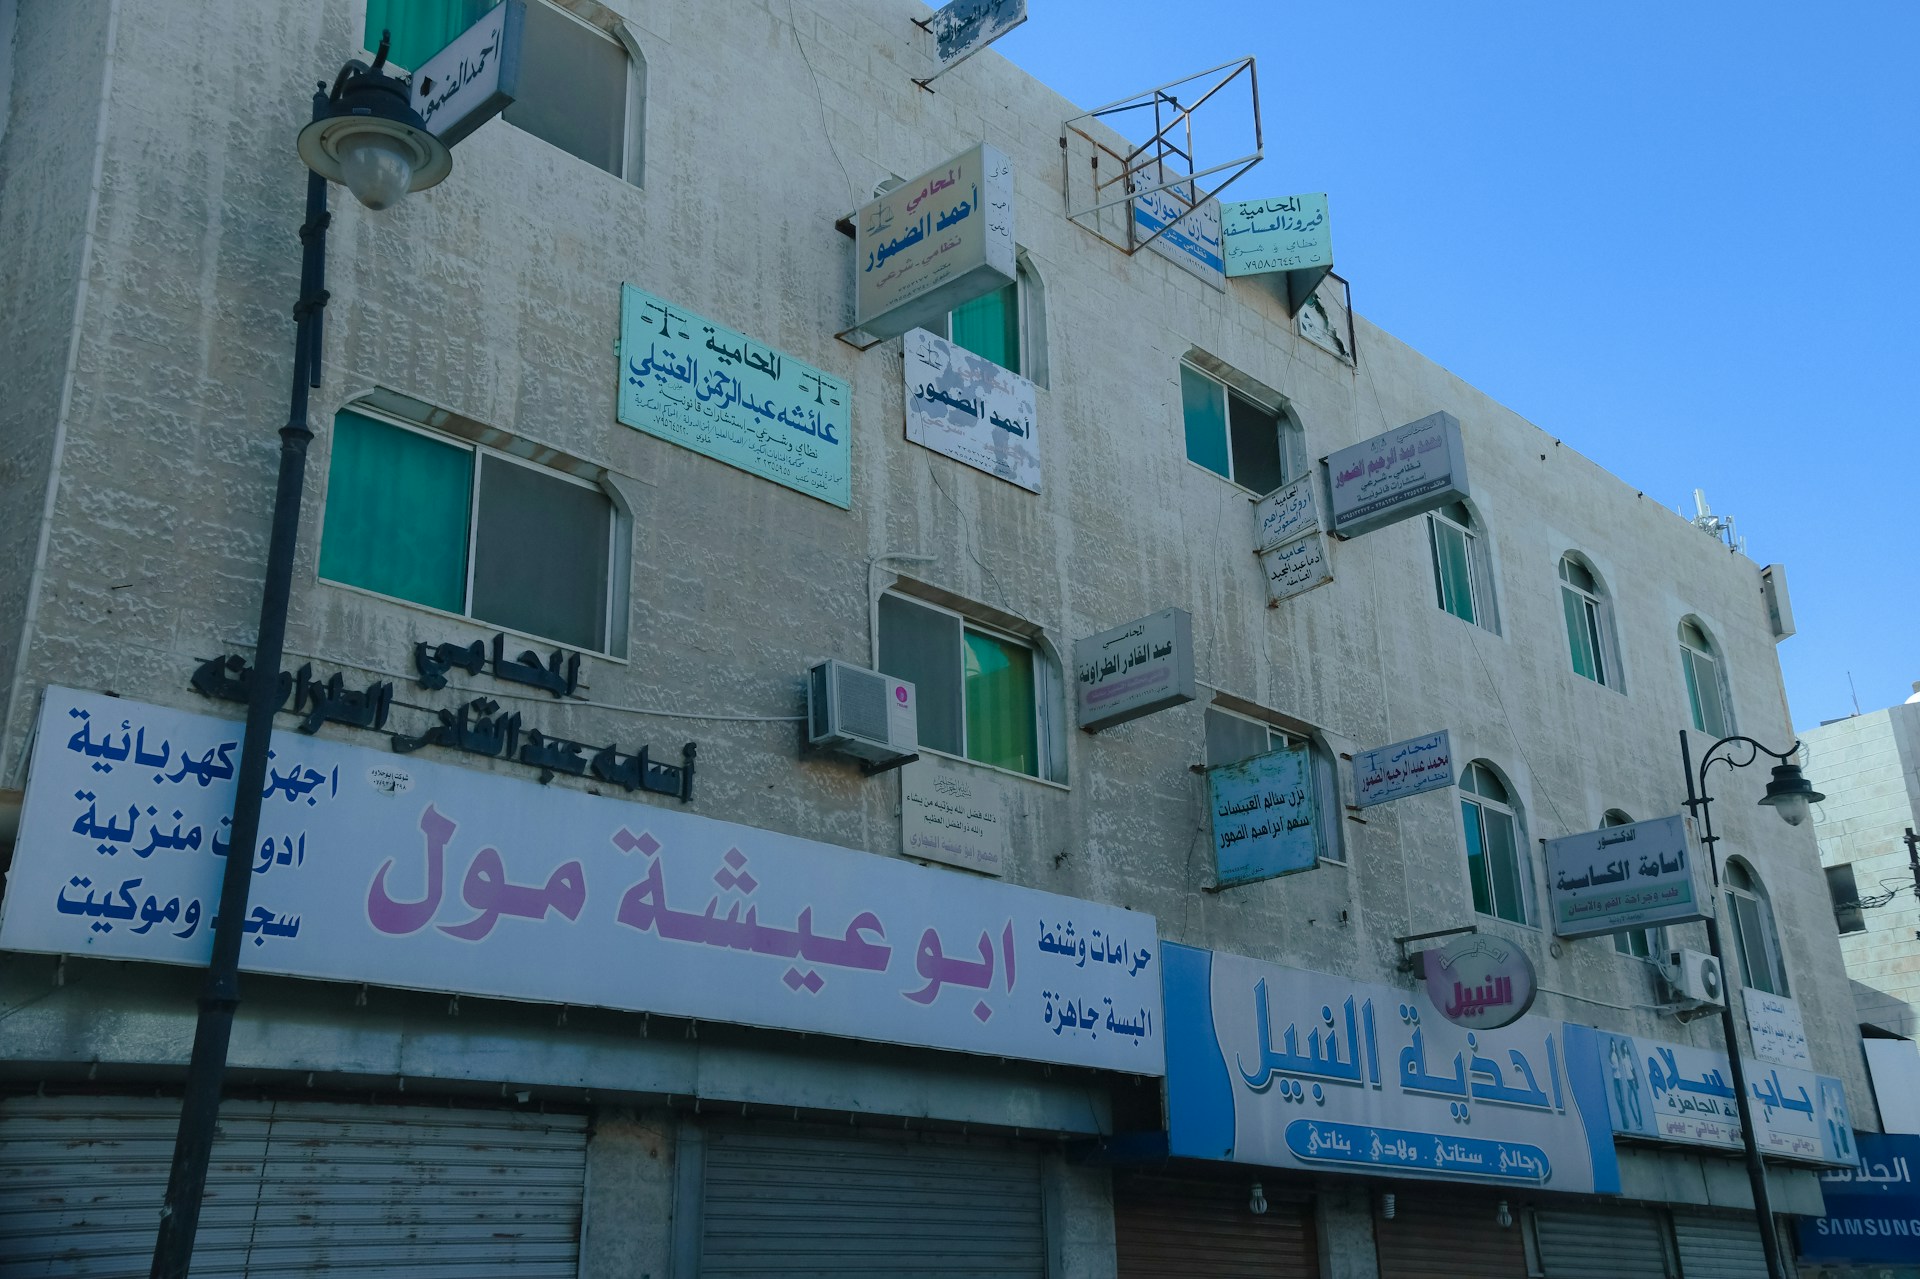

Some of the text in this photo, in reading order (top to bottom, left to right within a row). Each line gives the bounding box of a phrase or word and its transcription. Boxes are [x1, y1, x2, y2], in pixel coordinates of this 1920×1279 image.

[906, 166, 962, 217] المحامي
[1239, 196, 1301, 220] المحامية
[865, 182, 978, 273] أحمد الضمور
[1285, 208, 1323, 233] فيروز
[628, 341, 698, 389] العتيلي
[703, 326, 781, 383] المحامية
[658, 383, 703, 411] قانونية
[696, 368, 742, 410] الرحمن
[741, 393, 776, 425] عبد
[914, 383, 985, 420] الضمور
[756, 427, 793, 452] وشرعي
[796, 442, 818, 459] نظامي
[1399, 444, 1416, 463] عبد
[1335, 458, 1366, 489] الضمور
[1368, 446, 1397, 478] الرحيم
[1394, 459, 1421, 480] نظامي
[416, 632, 582, 698] المحامي
[1079, 640, 1172, 684] عبد القادر الطراونة
[391, 696, 522, 758] القادر
[67, 707, 339, 807] اجهز كهربائية
[520, 728, 588, 786] عبد
[1264, 791, 1286, 813] سالم
[72, 789, 306, 874] ادوت منزلية
[1220, 824, 1249, 849] الضمور
[1251, 816, 1285, 843] ابراهيم
[1597, 829, 1636, 851] الدكتور
[56, 875, 301, 947] سج وموكيت
[367, 803, 1016, 1024] ابو عيشة مول
[1038, 919, 1151, 978] حرامات وشنط
[1043, 989, 1152, 1048] البسة جاهزة
[1445, 974, 1512, 1020] النبيل
[1236, 977, 1565, 1120] احذية النبيل
[1647, 1046, 1737, 1100] سلام
[1667, 1091, 1720, 1117] الجاهزة
[1306, 1122, 1545, 1176] رجالي ستاتي ولادي بناتي
[1816, 1217, 1920, 1237] SAMSUNG
